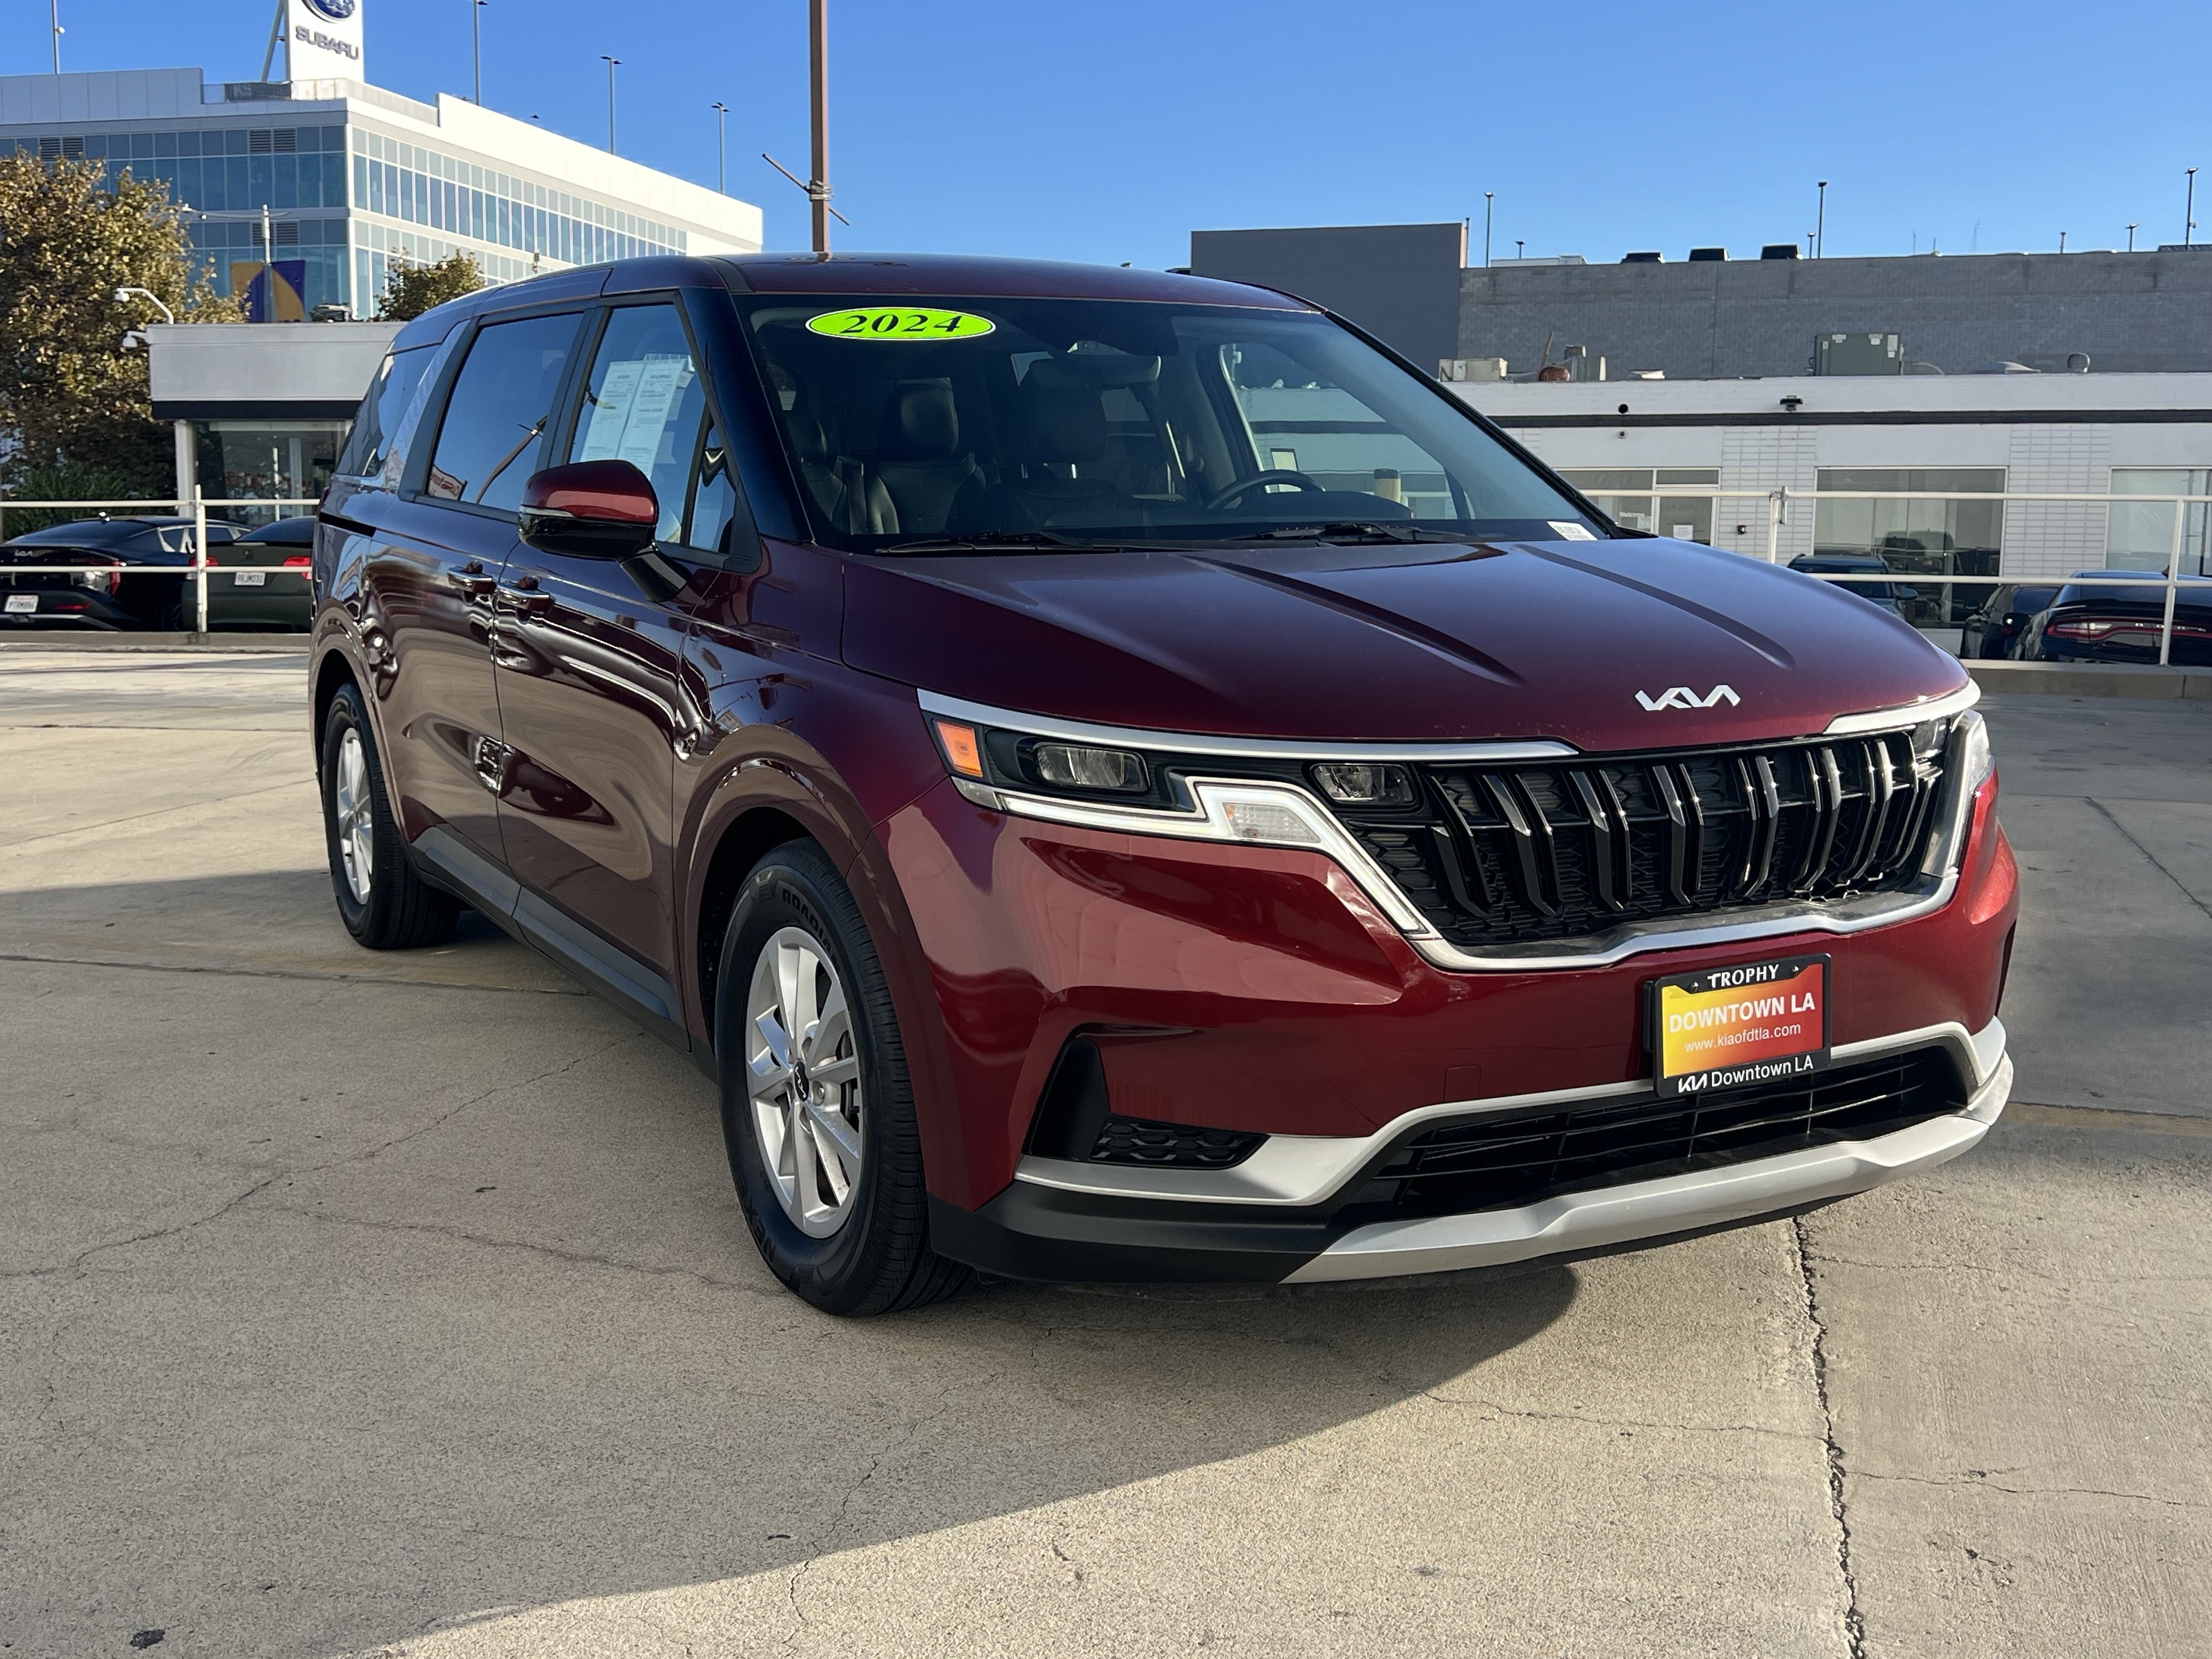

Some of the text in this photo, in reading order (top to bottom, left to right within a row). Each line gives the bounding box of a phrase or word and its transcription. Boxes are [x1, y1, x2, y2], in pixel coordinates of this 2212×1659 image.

[295, 25, 359, 60] SUBARU
[839, 314, 963, 333] 2024
[1634, 685, 1741, 711] KIA
[1707, 964, 1780, 988] TROPHY
[1669, 992, 1816, 1034] DOWNTOWN LA
[1685, 1024, 1802, 1052] www.kiaofdtla.com
[1678, 1054, 1814, 1093] KIA Downtown LA
